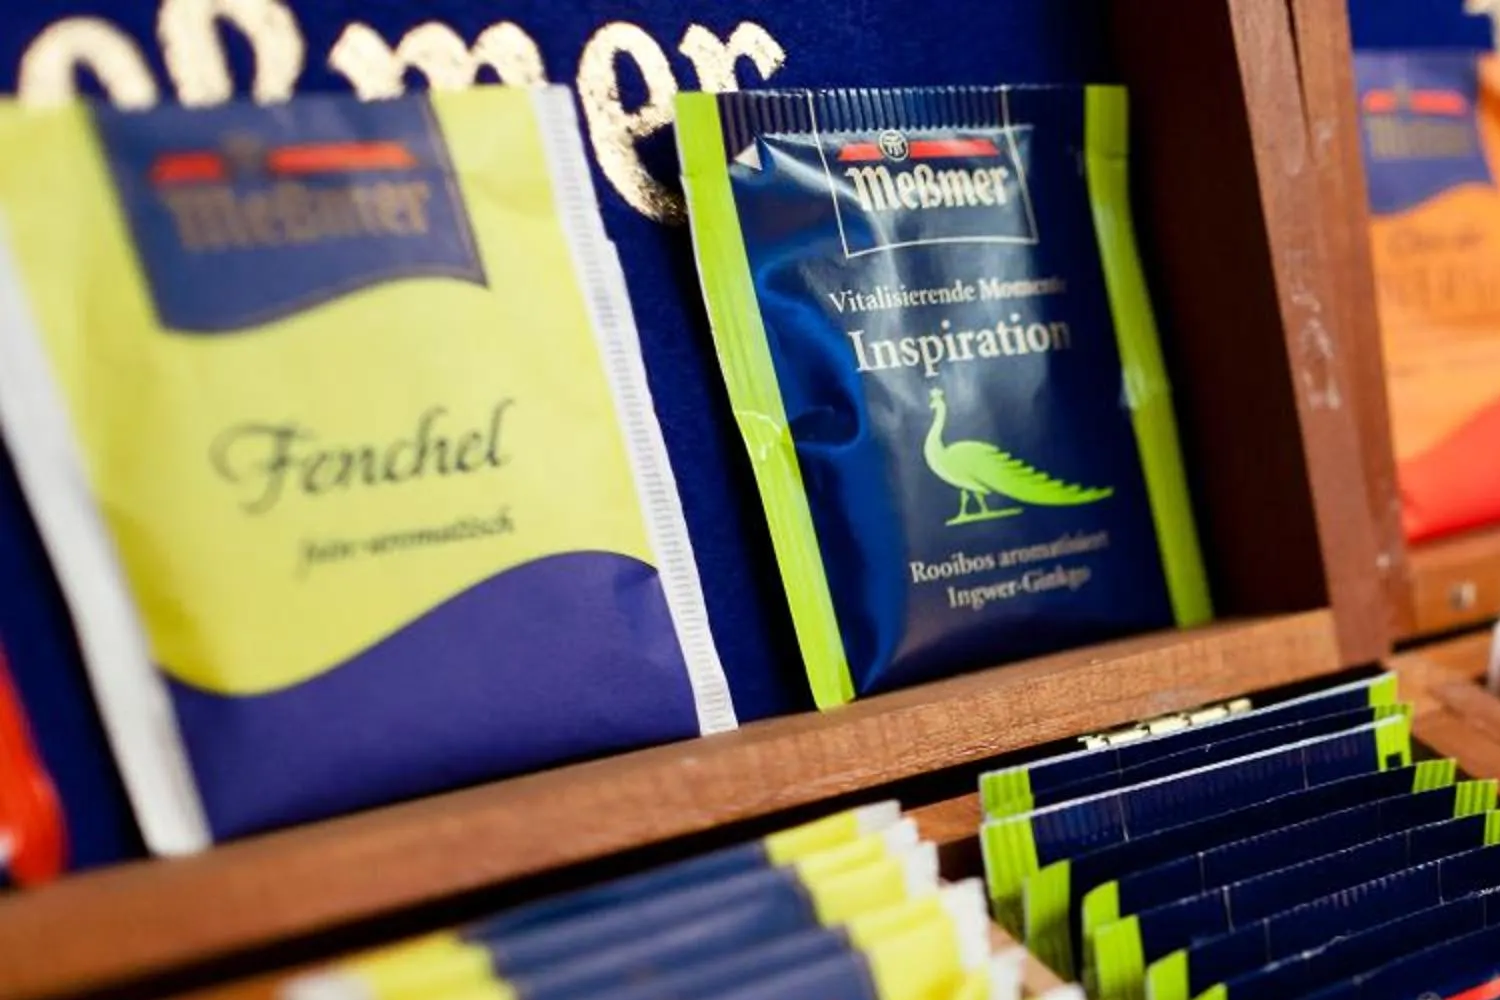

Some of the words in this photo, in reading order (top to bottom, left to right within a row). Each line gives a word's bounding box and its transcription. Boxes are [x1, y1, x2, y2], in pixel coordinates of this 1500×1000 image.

[844, 163, 1009, 212] Meßmer
[829, 279, 976, 313] Vitalisierende
[848, 312, 1071, 377] Inspiration
[207, 397, 516, 516] Fenchel
[909, 551, 995, 583] Rooibos
